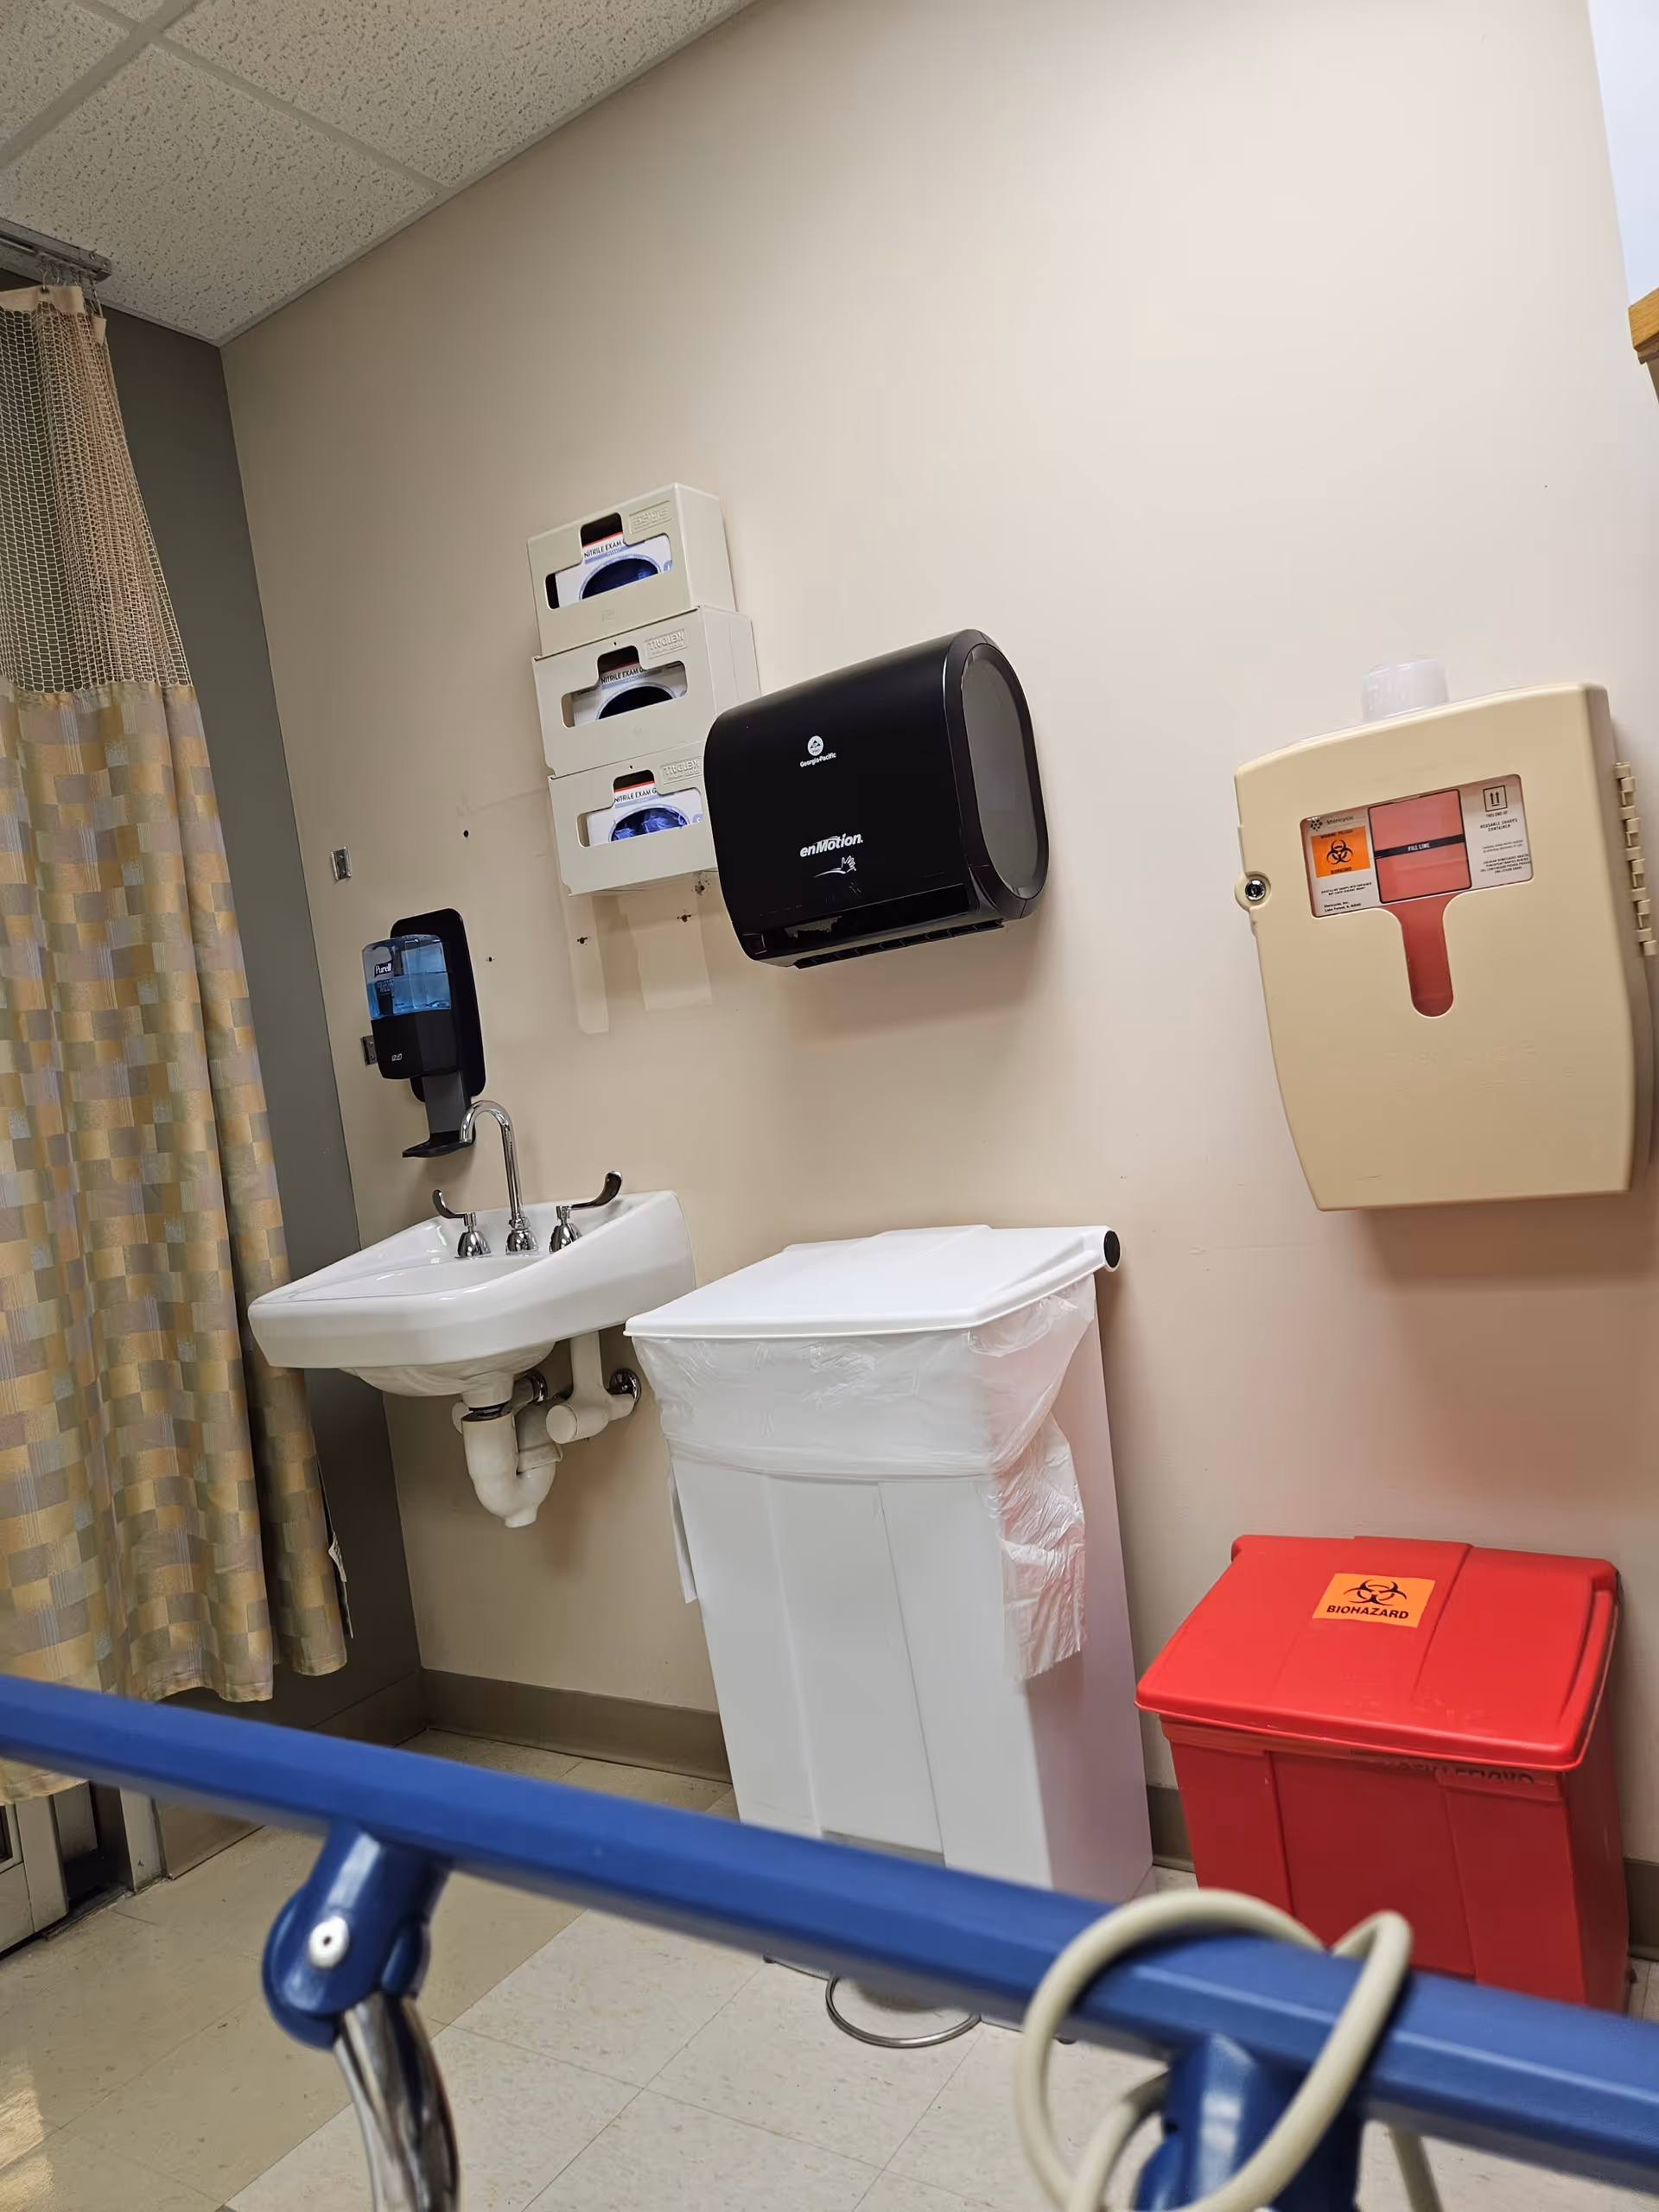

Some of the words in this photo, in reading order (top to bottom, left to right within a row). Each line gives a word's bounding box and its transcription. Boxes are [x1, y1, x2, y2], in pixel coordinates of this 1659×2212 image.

[584, 545, 605, 558] NITRILE
[605, 540, 622, 551] EXAM
[601, 672, 621, 684] NITRILE
[622, 668, 639, 678] EXAM
[614, 792, 634, 803] NITRILE
[635, 790, 652, 798] EXAM
[799, 832, 861, 857] enMotion
[1325, 1605, 1409, 1619] BIOHAZARD
